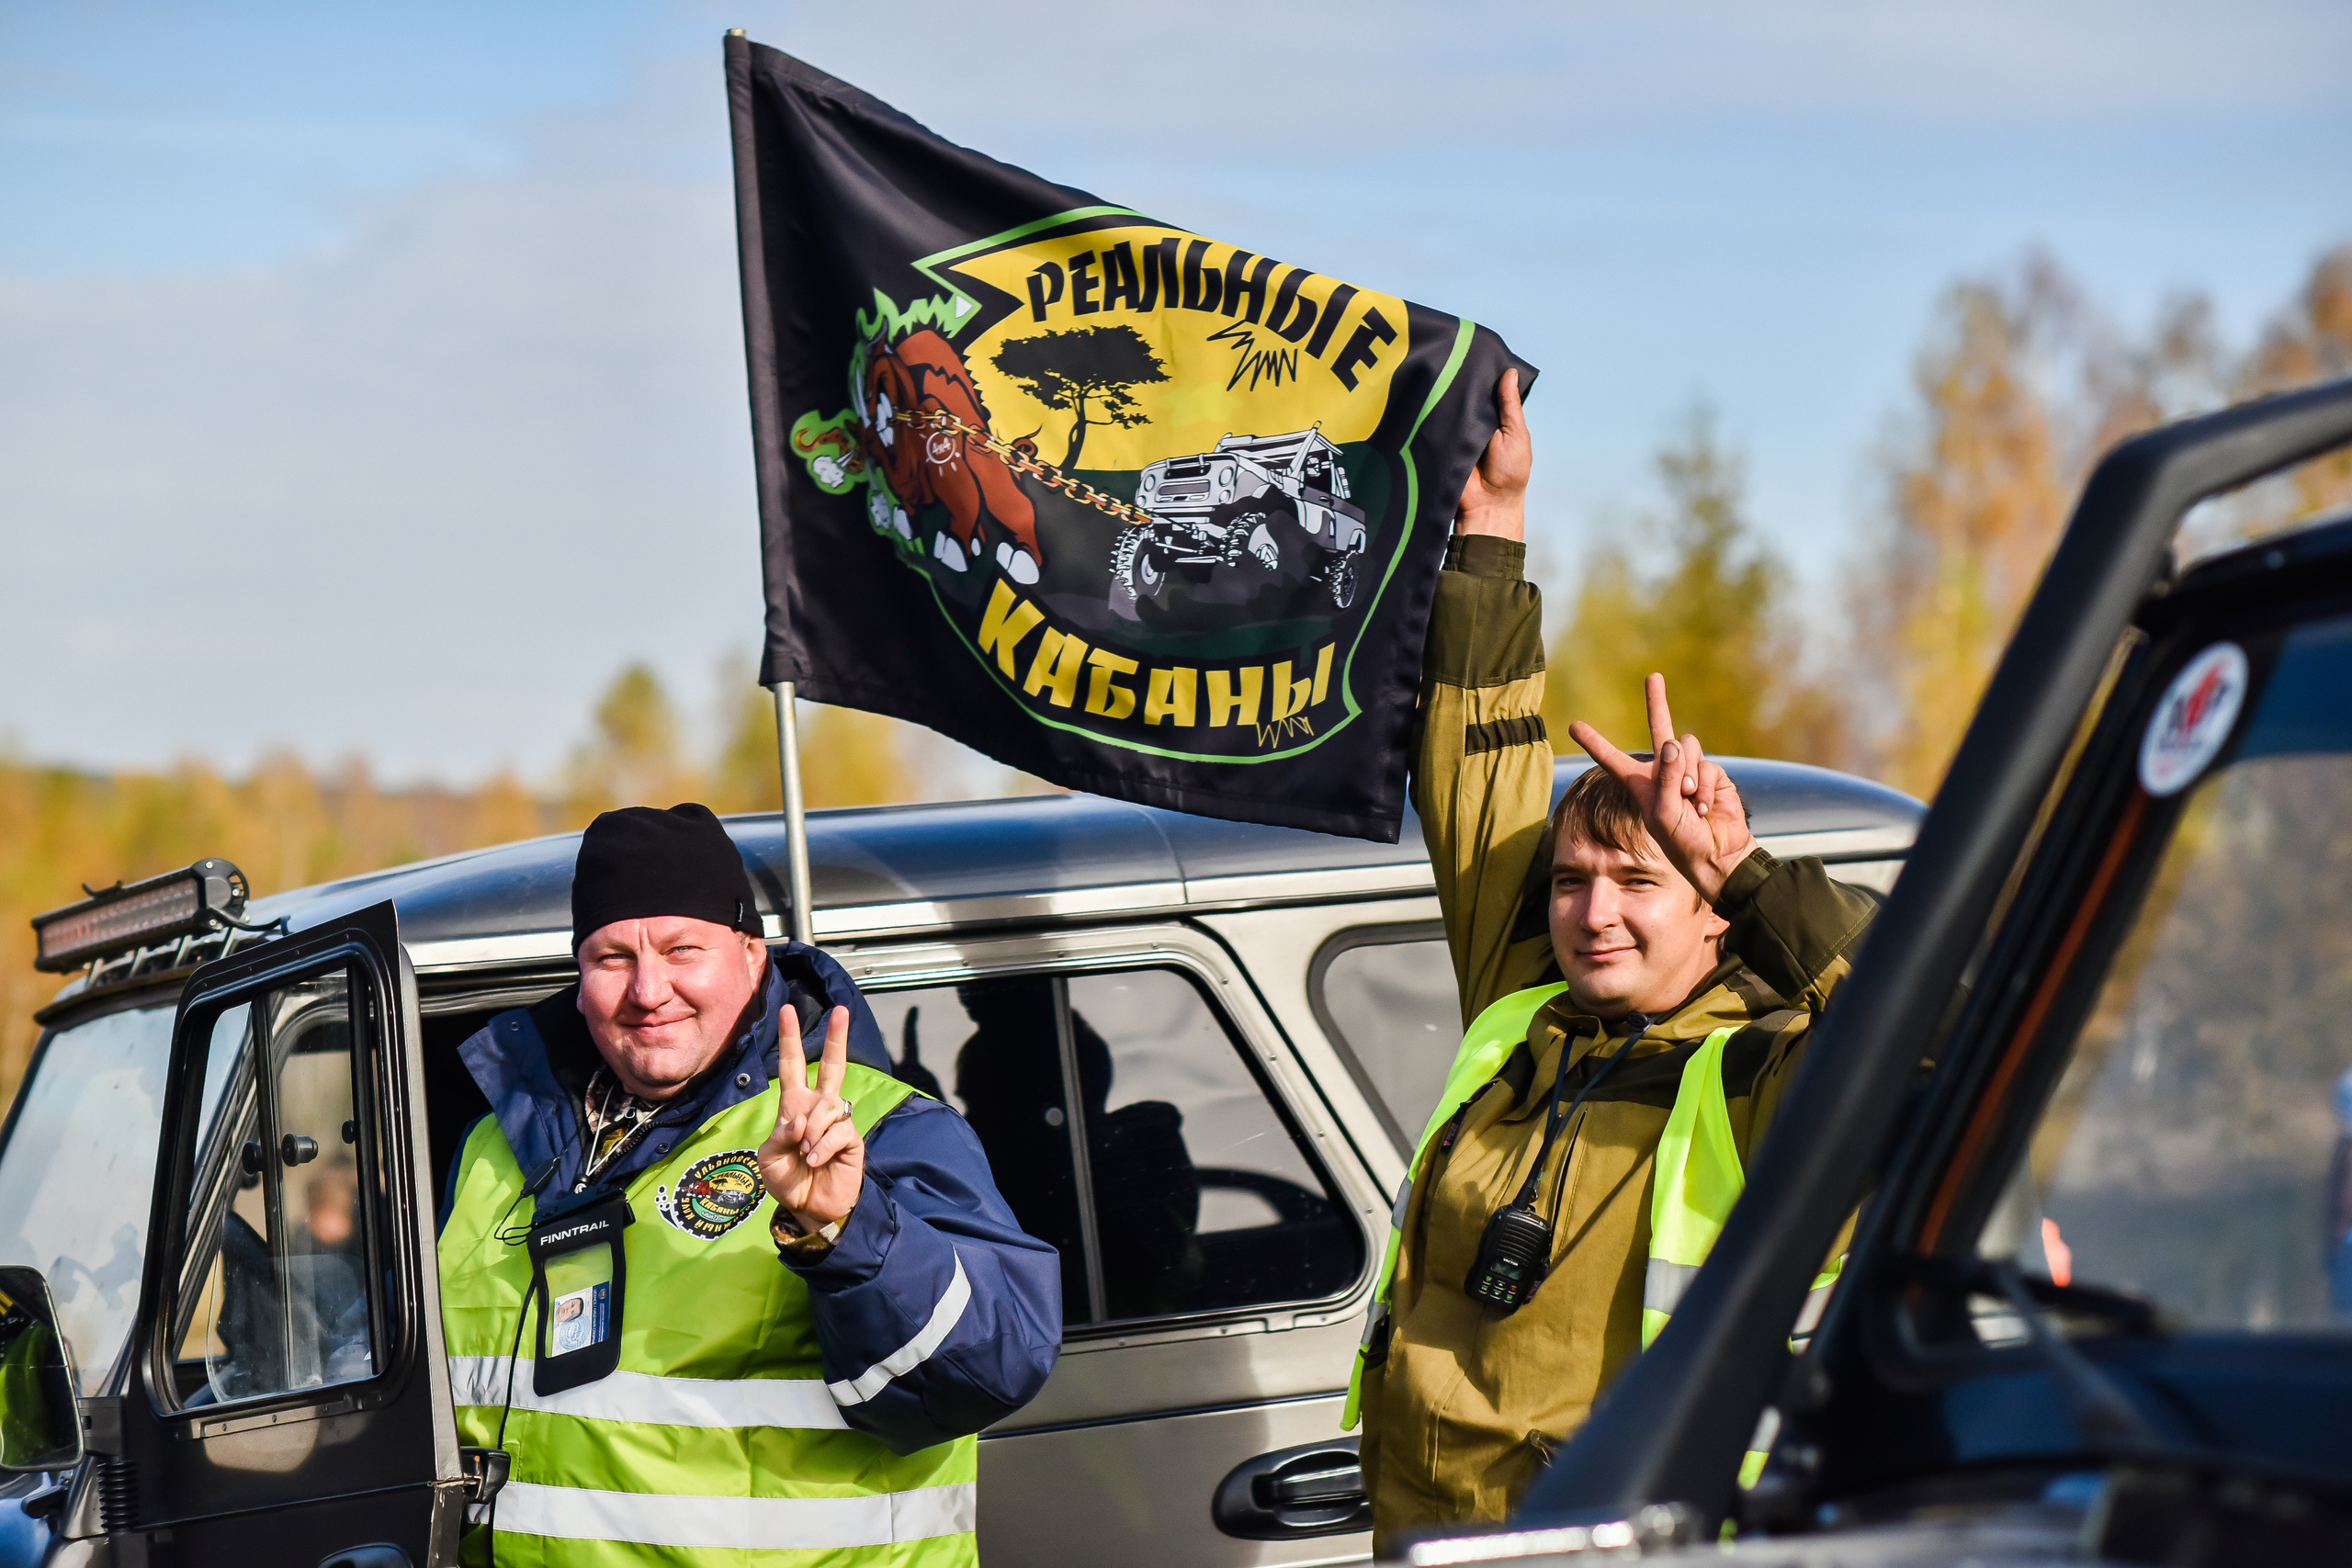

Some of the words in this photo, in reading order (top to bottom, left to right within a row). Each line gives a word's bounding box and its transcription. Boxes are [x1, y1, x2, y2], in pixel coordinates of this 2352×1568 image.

[1026, 238, 1397, 392] РЕАЛЬНЫЕ
[978, 578, 1335, 728] КАБАНЫ
[717, 1171, 752, 1189] РЕАЛЬНЫЕ
[699, 1197, 739, 1216] КАБАНЫ
[540, 1220, 609, 1246] FINNTRAIL
